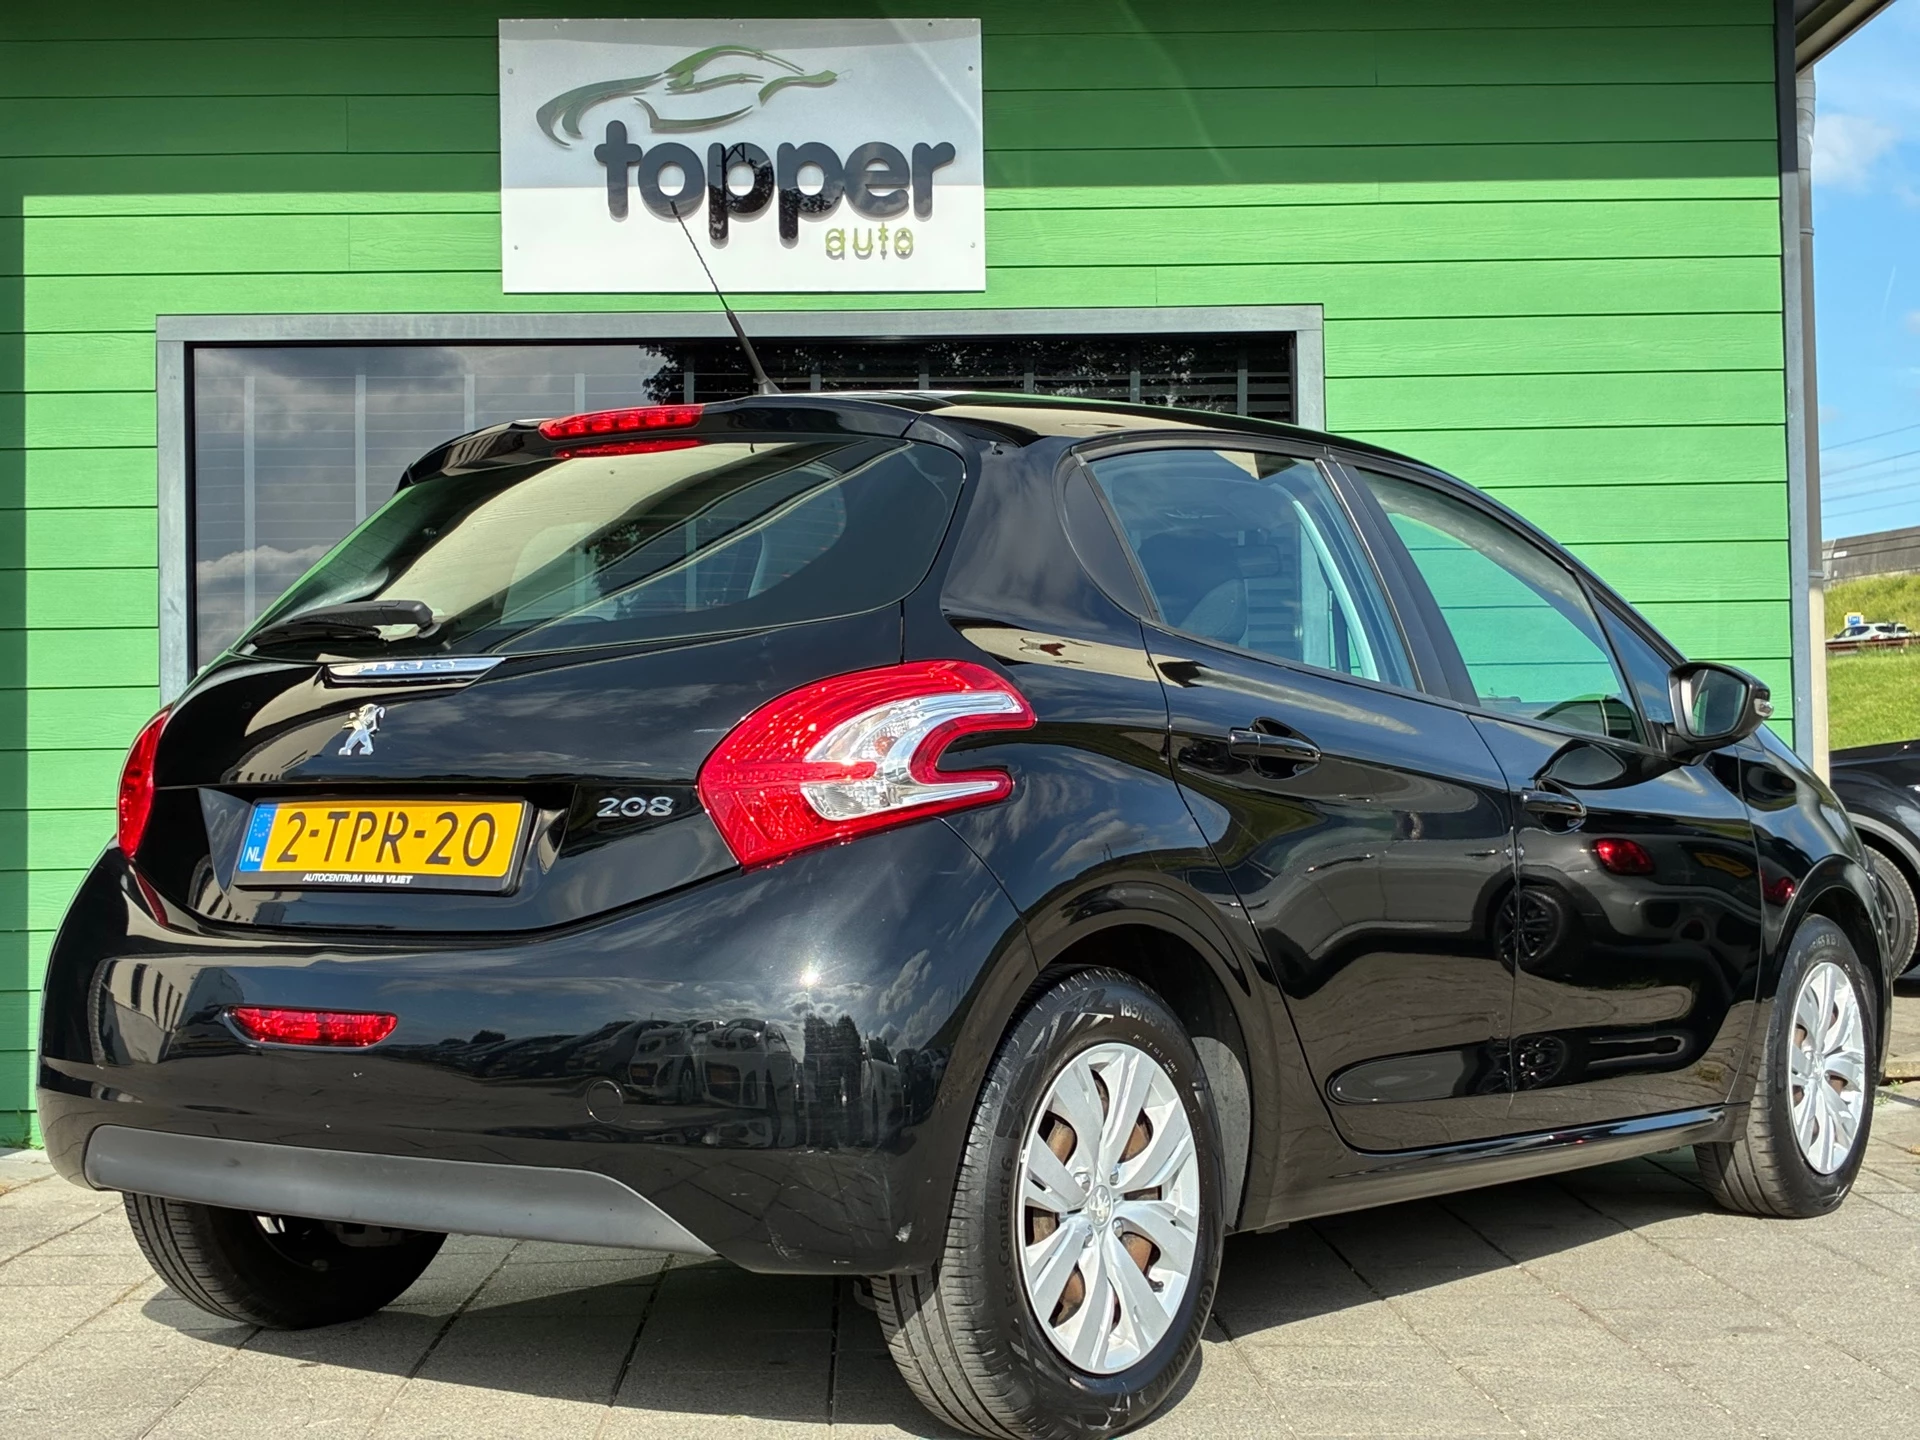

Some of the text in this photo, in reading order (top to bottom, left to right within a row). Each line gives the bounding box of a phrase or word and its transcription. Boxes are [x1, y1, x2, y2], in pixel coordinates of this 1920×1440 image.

[594, 120, 956, 244] topper
[825, 222, 914, 259] auto
[596, 796, 674, 818] 208
[276, 811, 496, 867] 2-TPR-20
[245, 846, 261, 863] NL
[302, 873, 413, 885] AUTOCENTRUM VAN VLIET
